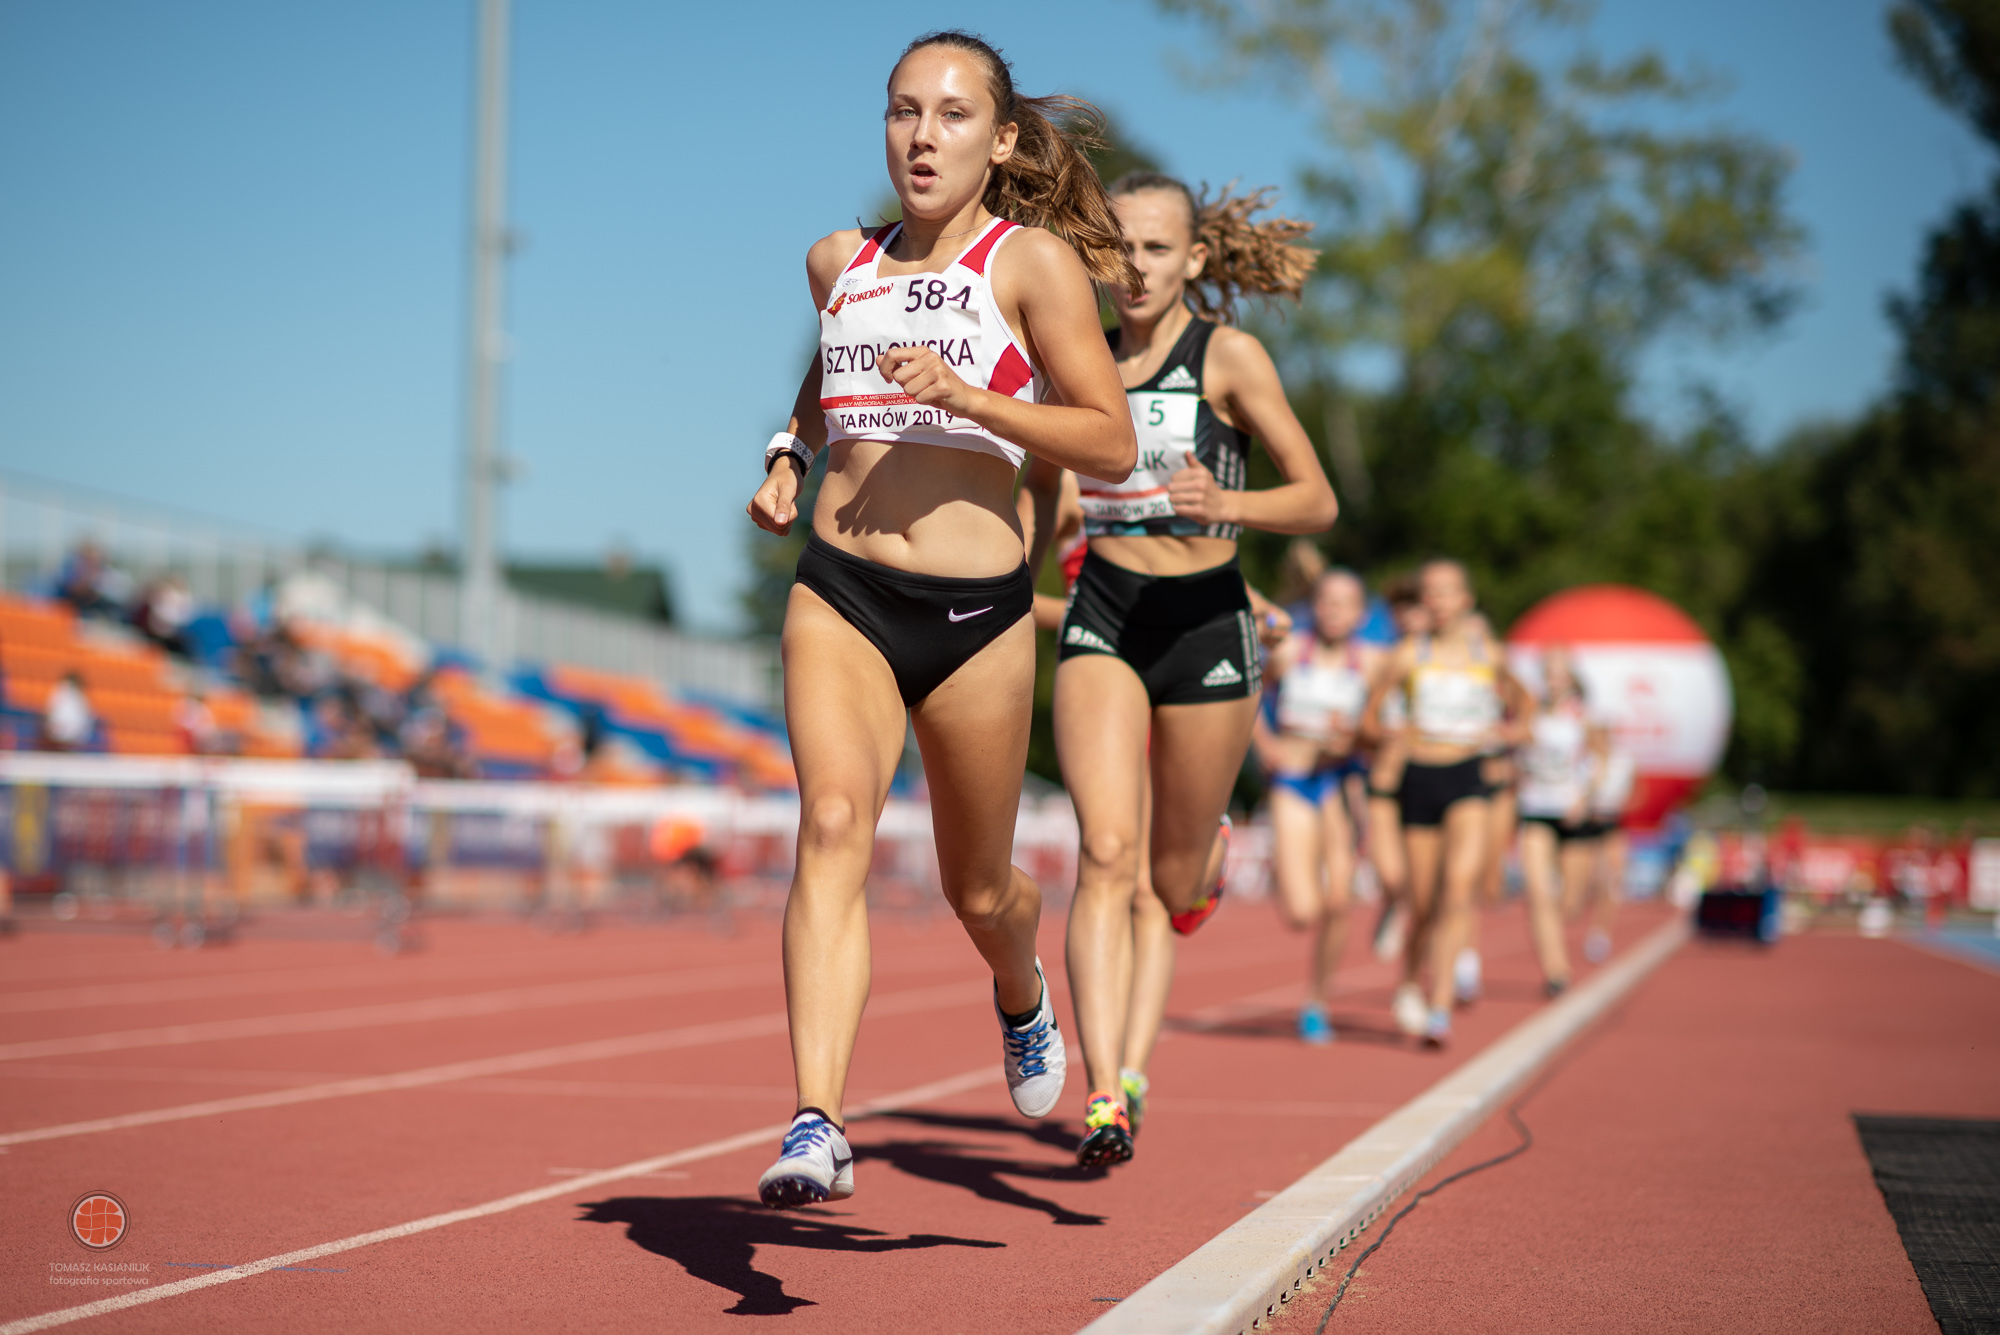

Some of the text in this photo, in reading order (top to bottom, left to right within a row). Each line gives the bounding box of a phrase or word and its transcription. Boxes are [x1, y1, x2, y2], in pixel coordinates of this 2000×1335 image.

[847, 283, 894, 305] SOKOŁÓW
[827, 338, 975, 375] SZYDKA
[840, 407, 954, 430] TARNÓW 2019
[1095, 502, 1144, 518] TARNÓW
